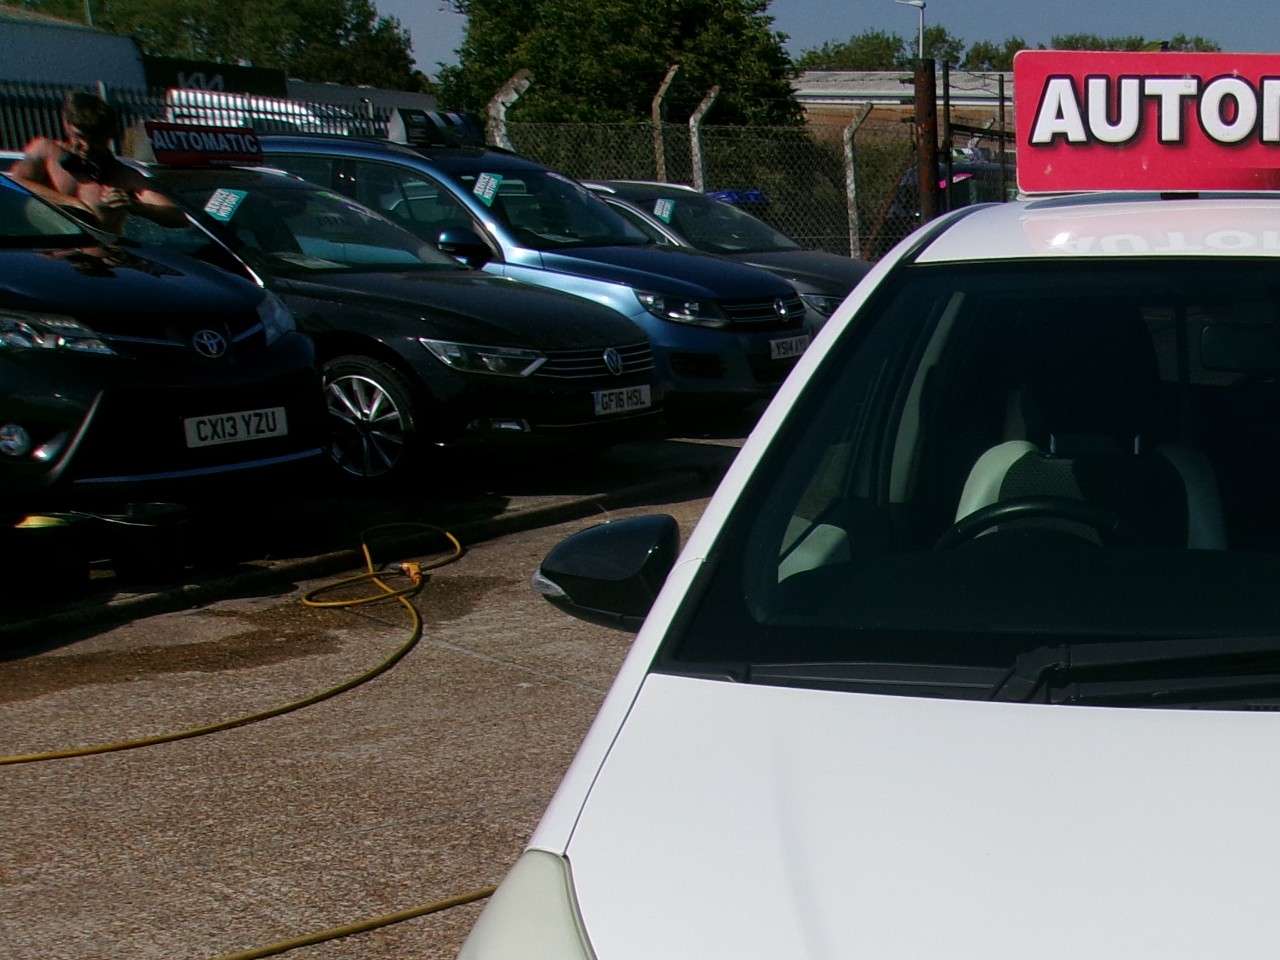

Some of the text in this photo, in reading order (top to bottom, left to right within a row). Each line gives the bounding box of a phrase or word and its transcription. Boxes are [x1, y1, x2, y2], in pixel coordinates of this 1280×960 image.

[152, 129, 259, 153] AUTOMATIC
[196, 411, 277, 441] CX13 YZU
